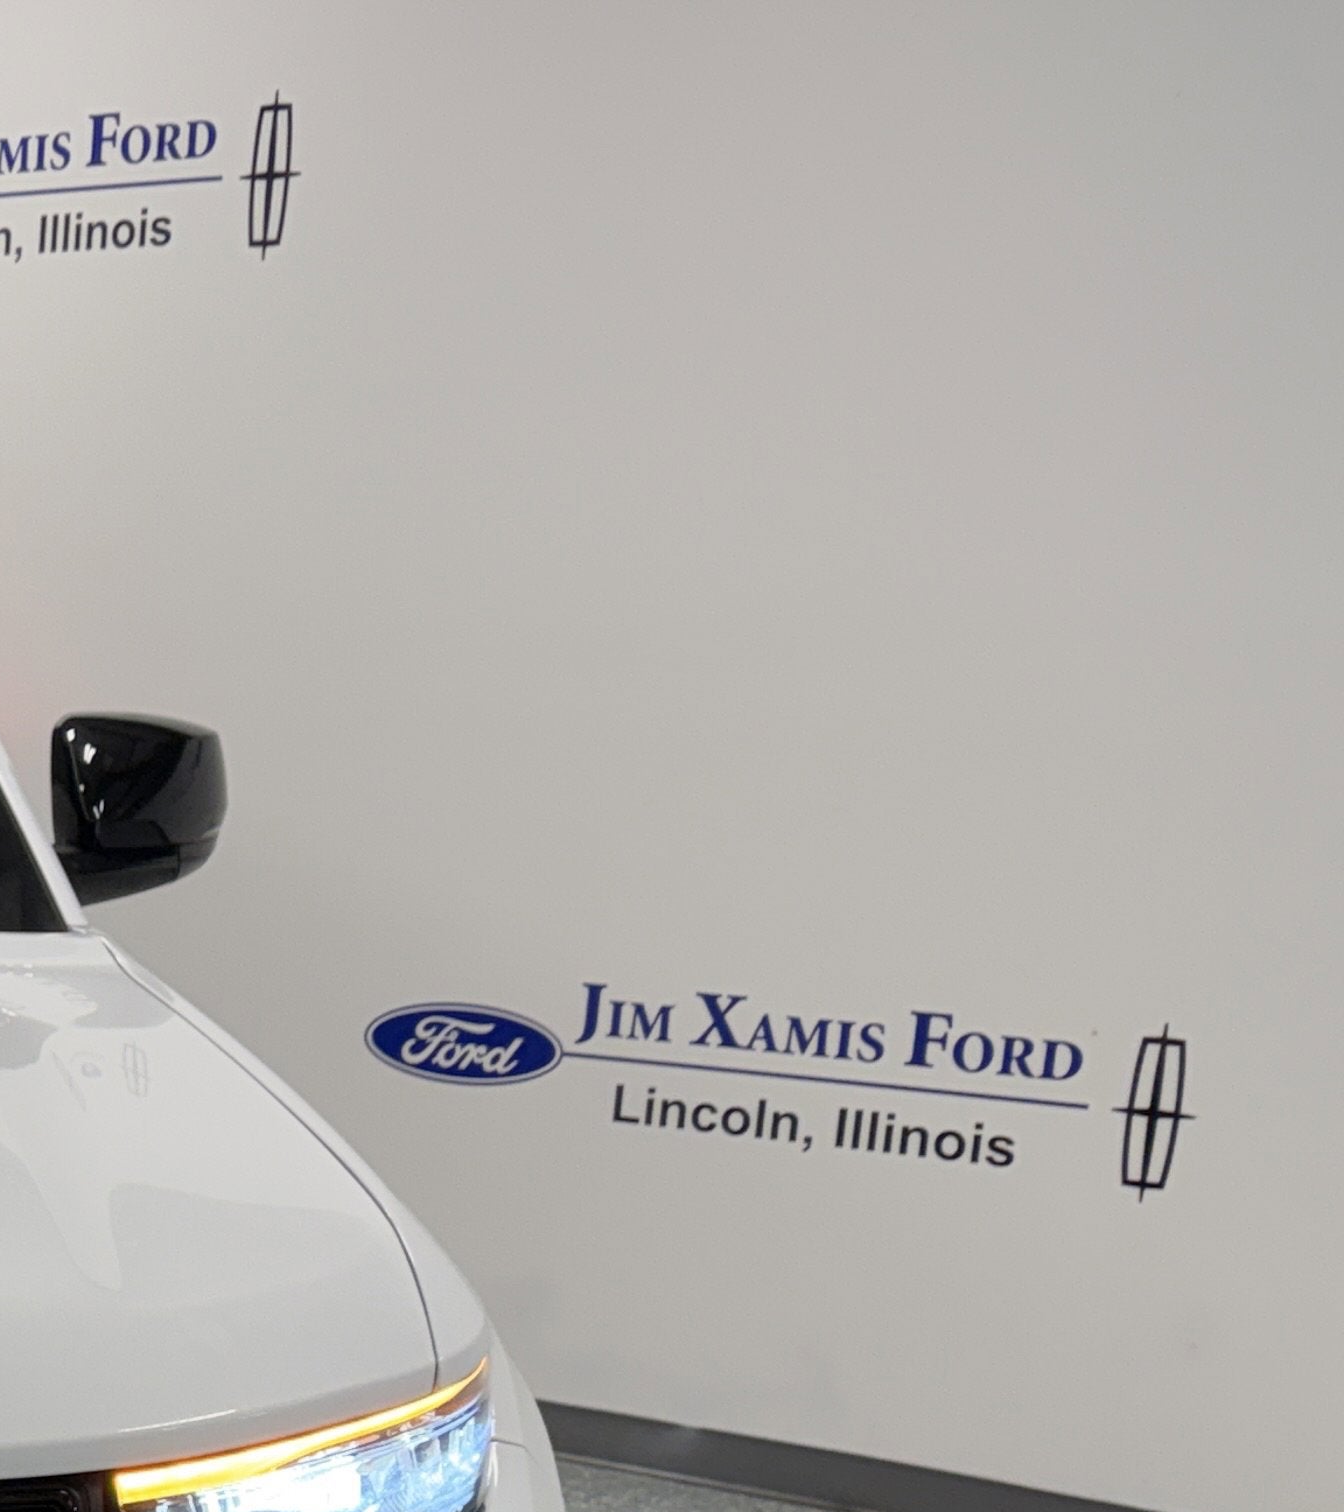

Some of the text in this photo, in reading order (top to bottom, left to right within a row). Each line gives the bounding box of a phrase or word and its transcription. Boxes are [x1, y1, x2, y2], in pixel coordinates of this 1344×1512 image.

[38, 207, 172, 254] Illinois
[400, 1014, 524, 1076] Ford
[611, 1083, 1016, 1168] Lincoln, Illinois
